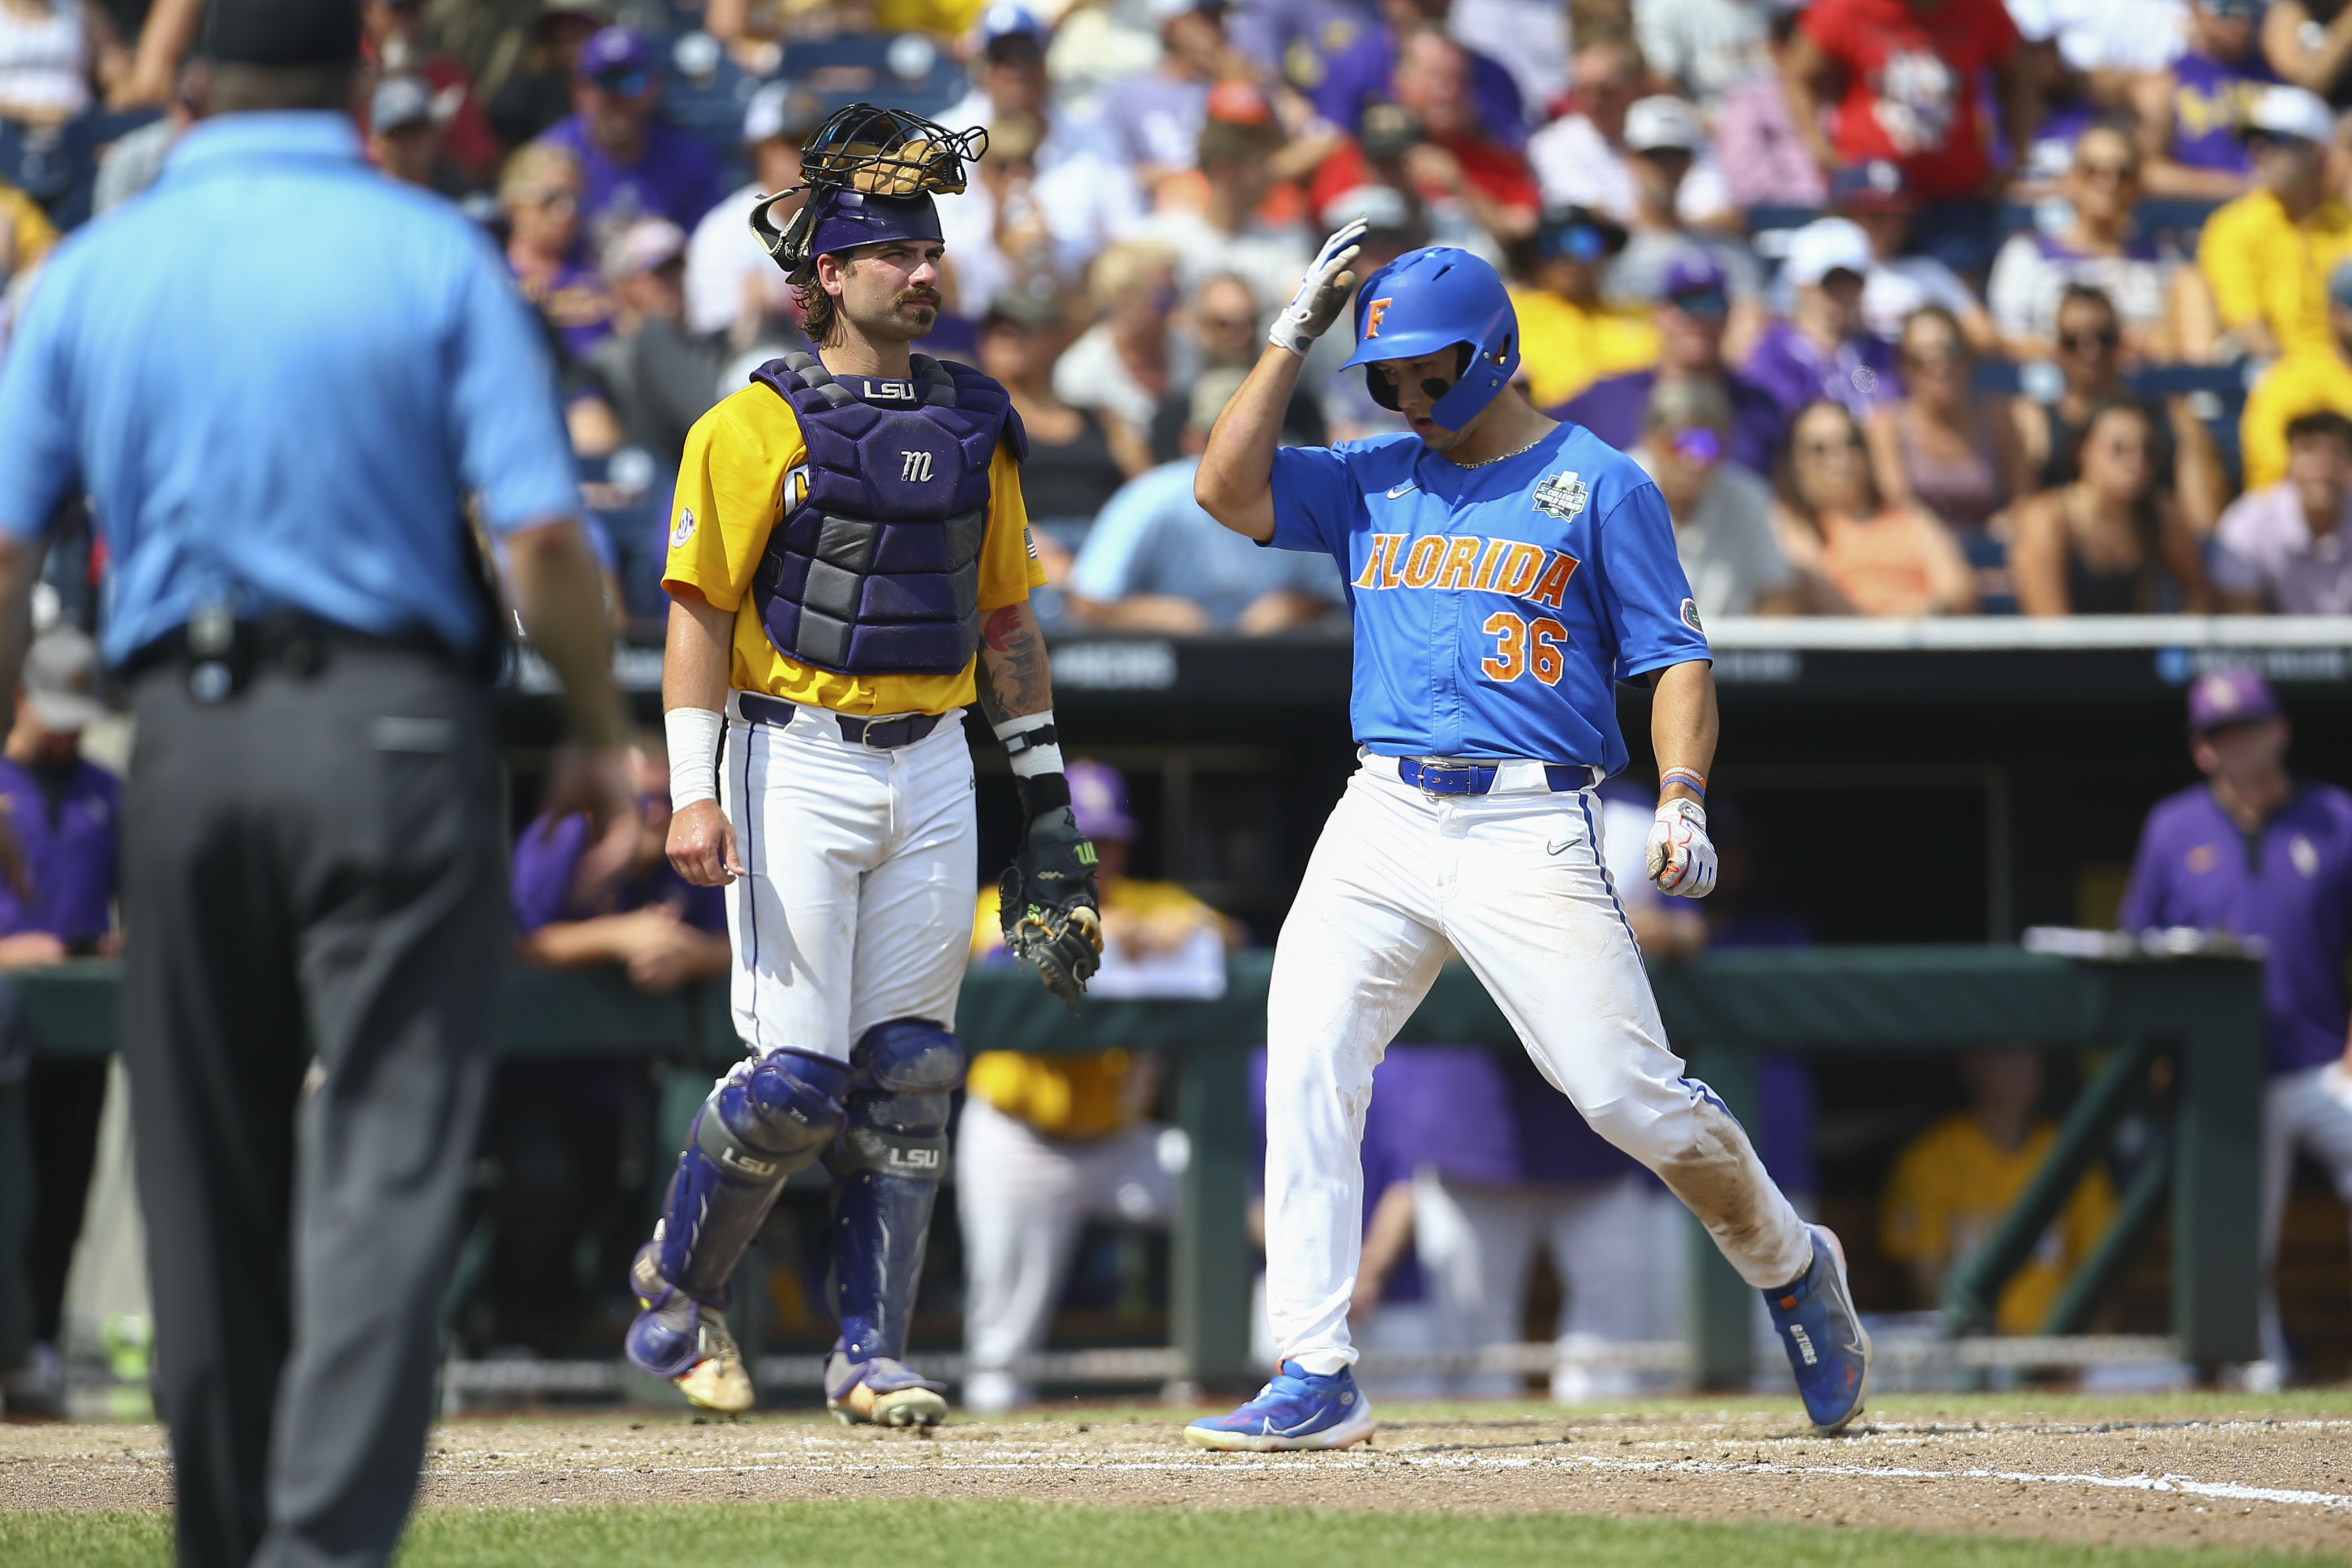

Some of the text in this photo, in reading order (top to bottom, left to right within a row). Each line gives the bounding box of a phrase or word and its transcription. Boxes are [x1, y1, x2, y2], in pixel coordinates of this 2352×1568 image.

[1364, 297, 1392, 340] F
[864, 380, 915, 401] LSU
[1535, 492, 1559, 504] WORLD
[1557, 499, 1582, 511] SERIES
[1547, 489, 1575, 502] COLLEGE
[1350, 532, 1581, 609] FLORIDA
[1481, 611, 1568, 687] 36
[721, 1146, 778, 1176] LSU
[889, 1148, 939, 1169] LSU
[1789, 1324, 1818, 1365] GATORS
